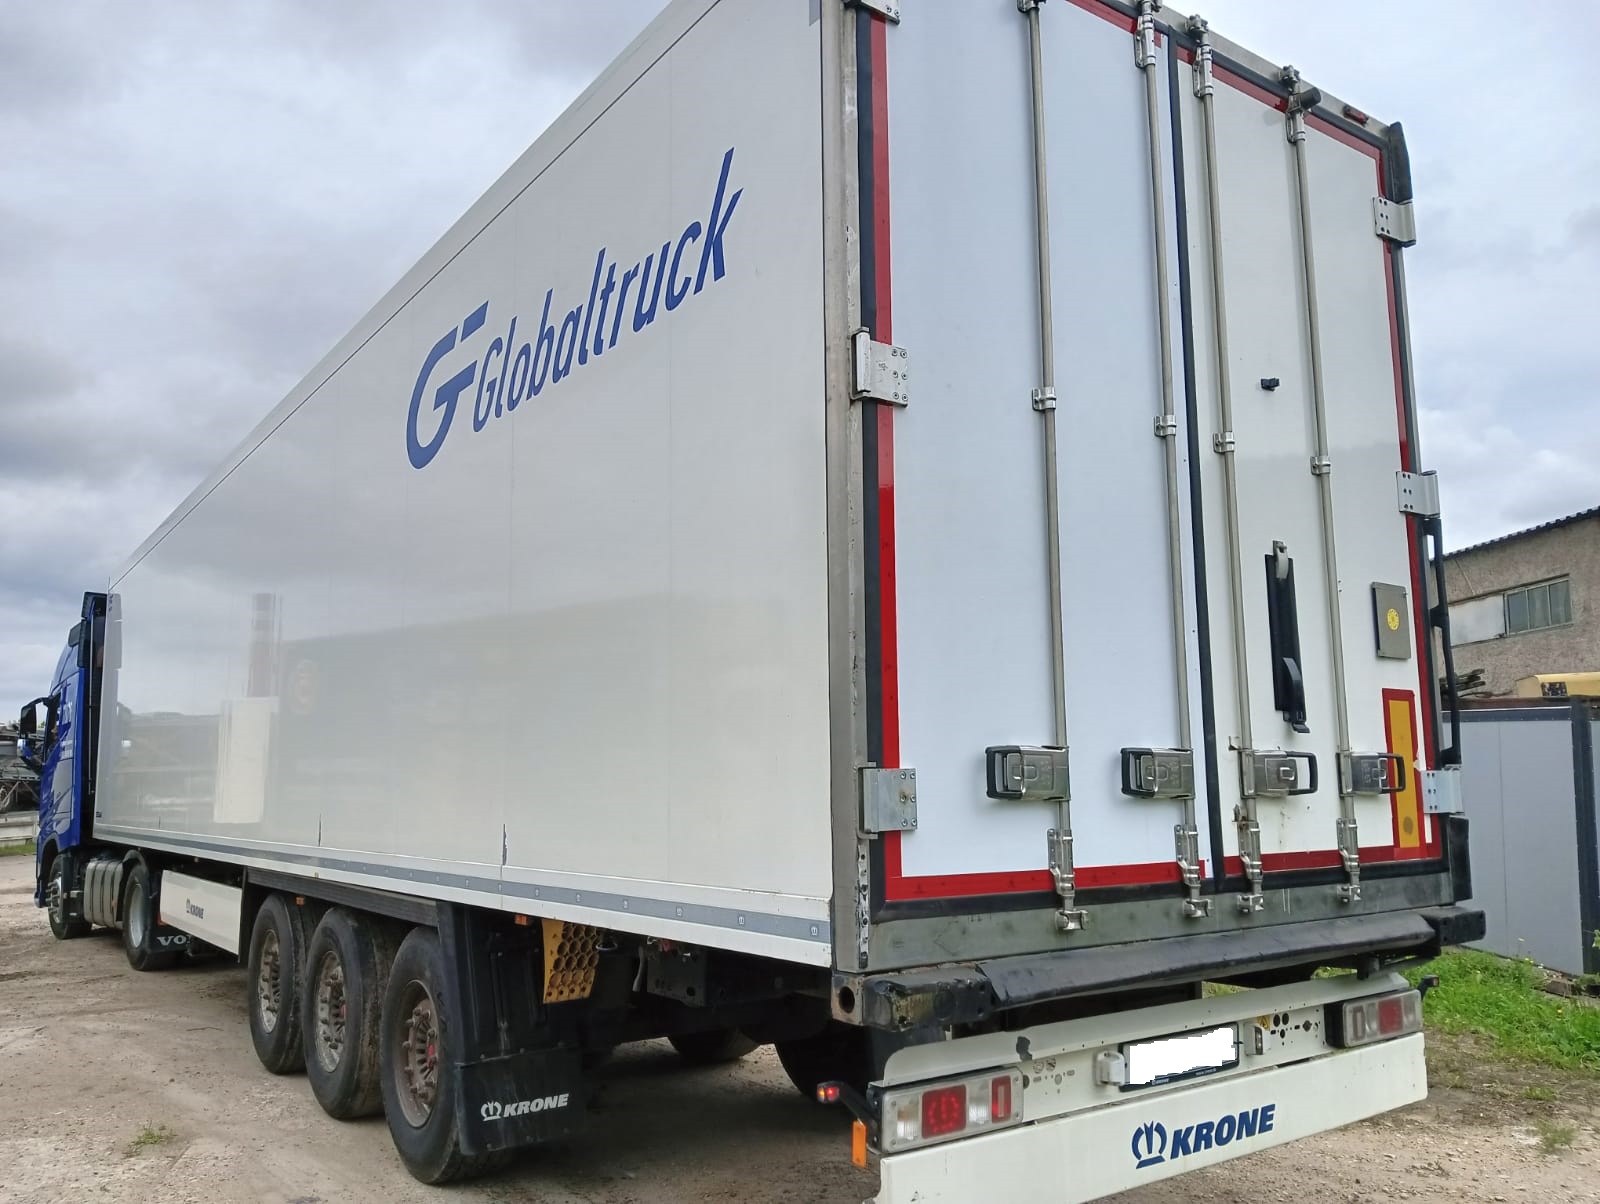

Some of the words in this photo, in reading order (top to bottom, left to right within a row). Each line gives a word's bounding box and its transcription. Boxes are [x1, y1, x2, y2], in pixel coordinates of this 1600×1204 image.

[473, 147, 744, 433] Globaltruck
[503, 1093, 569, 1117] KRONE
[1170, 1103, 1276, 1160] KRONE
